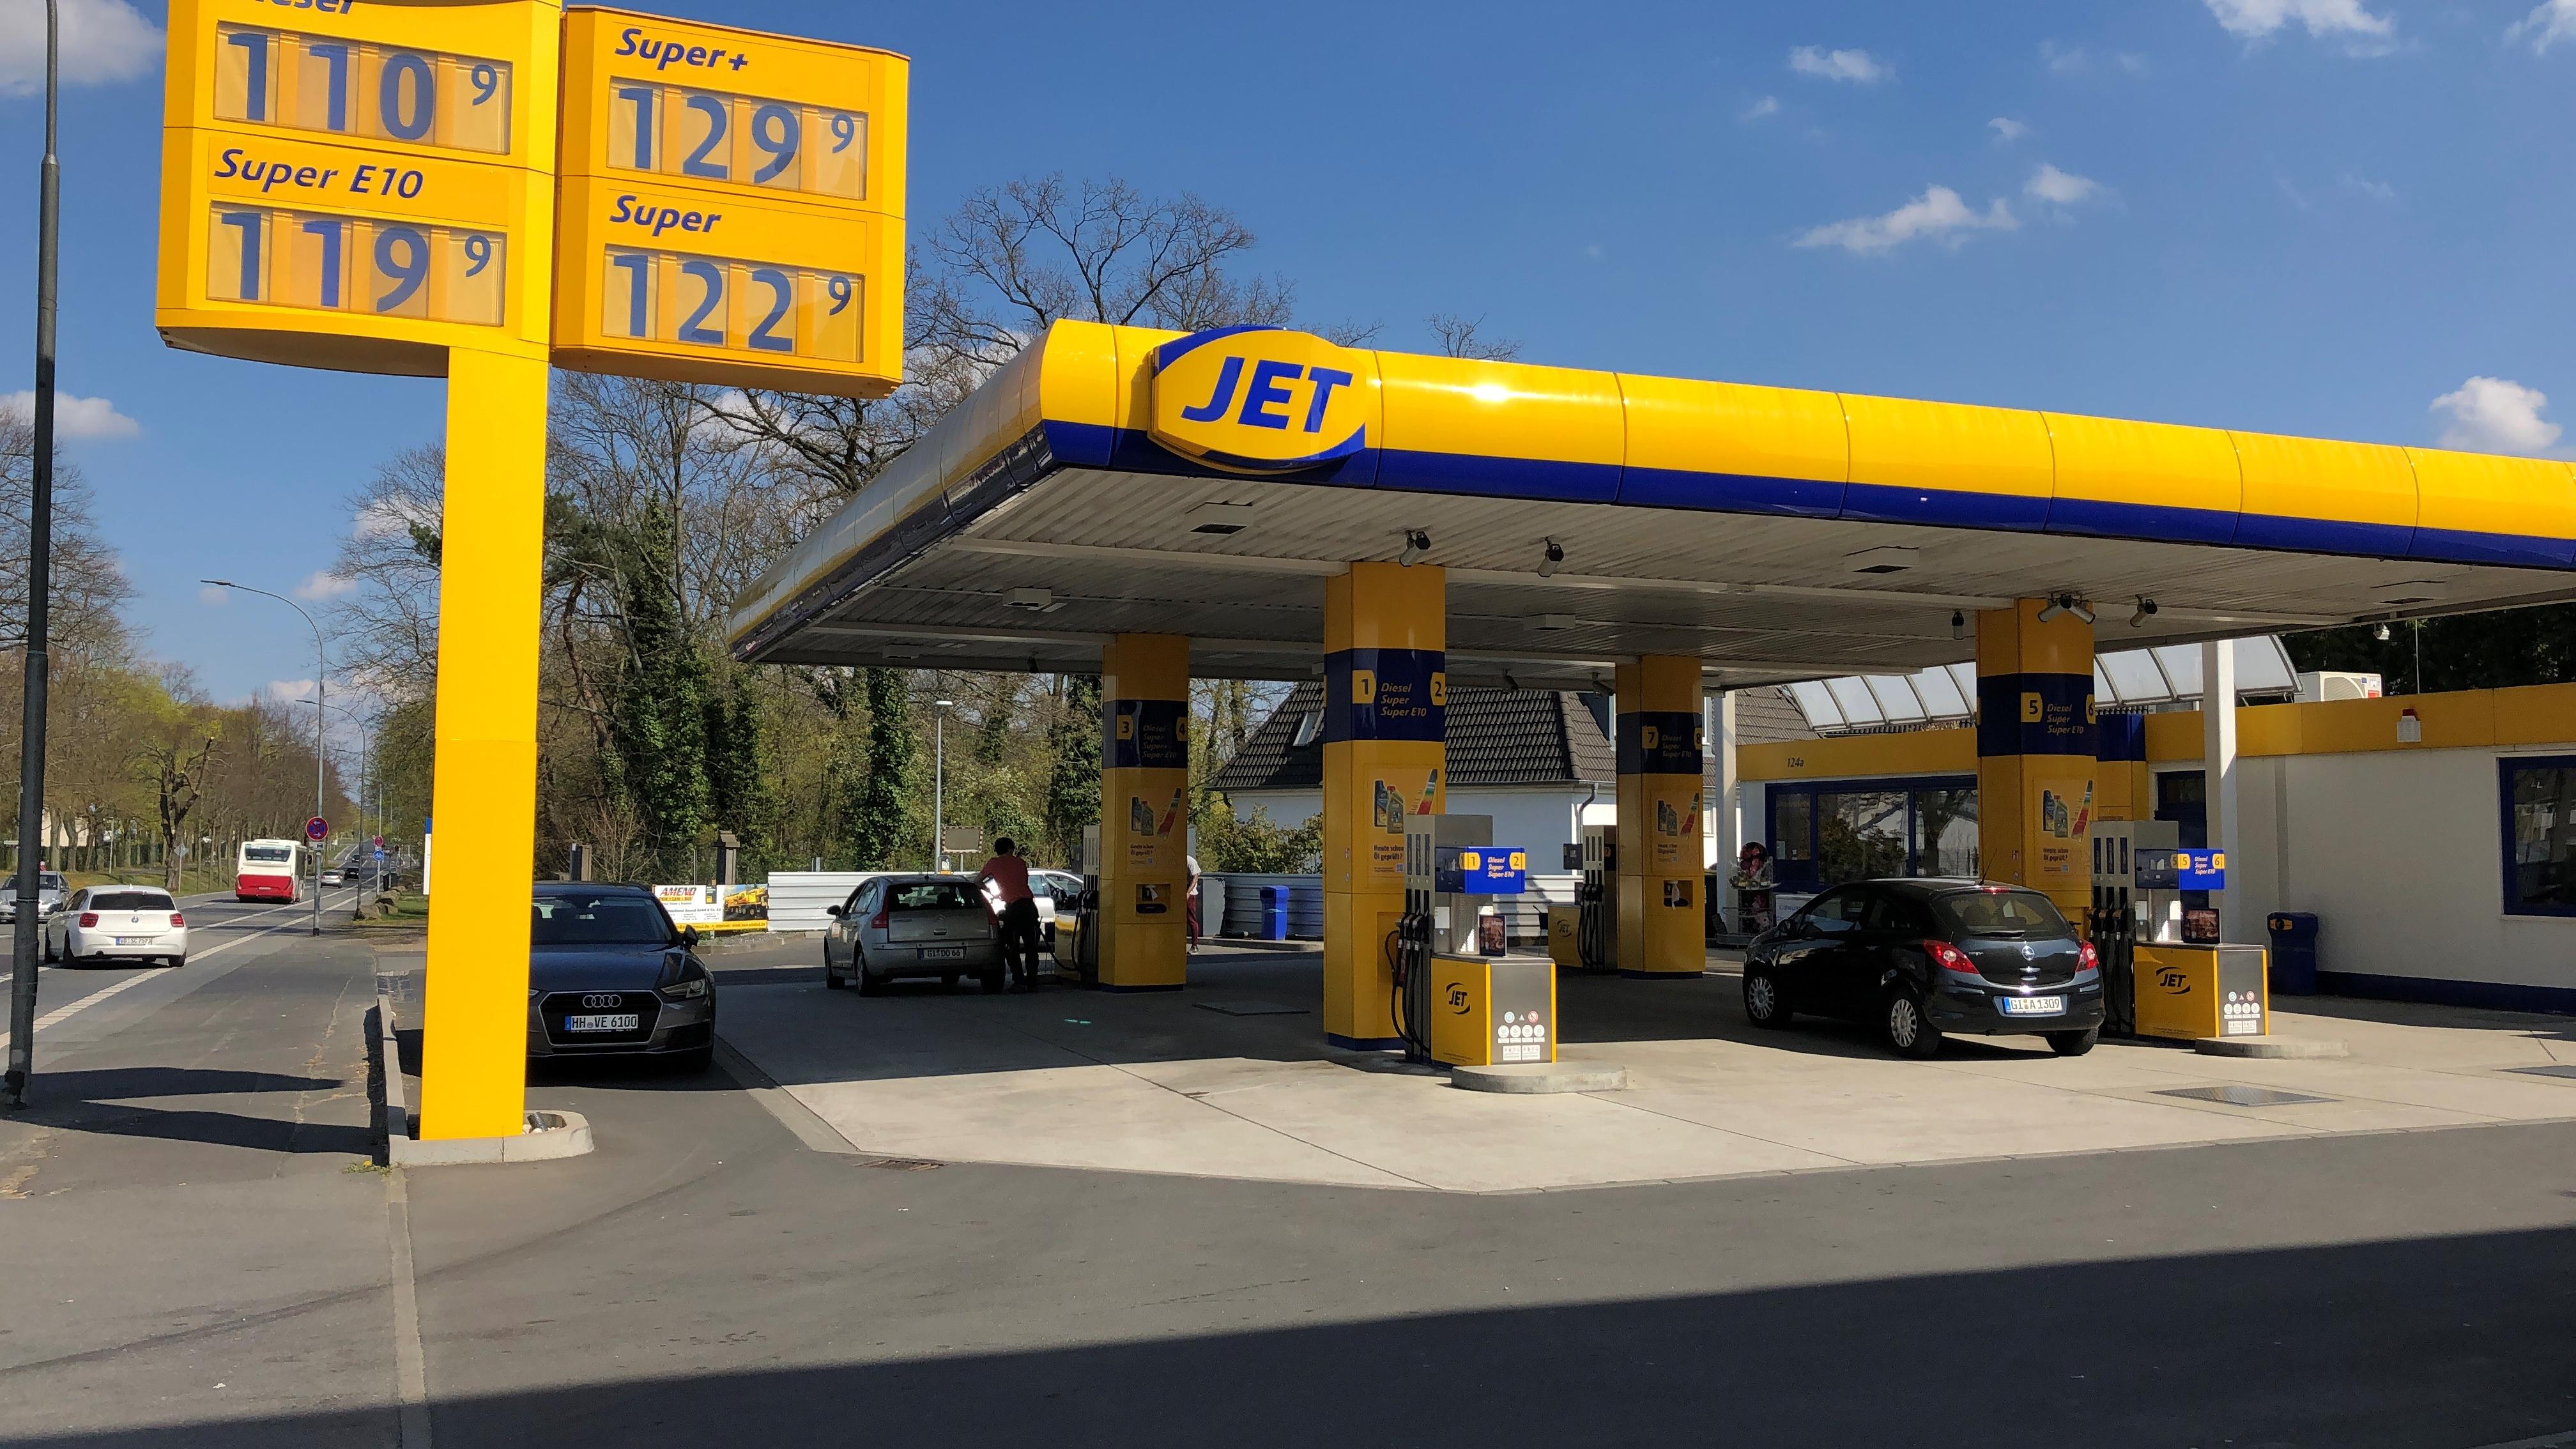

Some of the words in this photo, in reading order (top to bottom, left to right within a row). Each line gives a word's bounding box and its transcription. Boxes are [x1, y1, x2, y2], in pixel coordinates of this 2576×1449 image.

[615, 28, 749, 71] Super+
[227, 33, 434, 140] 110
[471, 65, 497, 105] 9
[619, 88, 799, 184] 129
[831, 114, 854, 153] 9
[214, 148, 339, 192] Super
[349, 164, 423, 198] E10
[609, 195, 722, 236] Super
[221, 212, 428, 312] 119
[464, 235, 491, 277] 9
[613, 255, 792, 350] 122
[828, 276, 851, 316] 9
[1180, 356, 1353, 433] JET
[1361, 678, 1368, 694] 1
[1381, 683, 1412, 693] Diesel
[1435, 681, 1442, 696] 2
[1381, 695, 1409, 707] Super
[2029, 700, 2038, 714] 5
[1381, 707, 1409, 718] Super
[1411, 707, 1427, 717] E10
[2047, 703, 2073, 712] Diesel
[2089, 702, 2094, 716] 6
[2047, 714, 2071, 724] Super
[1121, 721, 1130, 733] 3
[1179, 723, 1186, 735] 4
[2047, 725, 2071, 736] Super
[1648, 732, 1655, 743] 7
[1696, 733, 1701, 744] 8
[1787, 757, 1804, 767] 124a
[1471, 856, 1475, 866] 1
[1513, 856, 1519, 866] 2
[2182, 857, 2188, 865] 5
[2214, 857, 2220, 865] 6
[660, 887, 697, 896] AMEND
[2159, 973, 2186, 988] JET
[1448, 990, 1468, 1007] JET
[2011, 999, 2023, 1009] GI
[2030, 999, 2035, 1009] A
[2037, 999, 2060, 1009] 1309
[572, 1016, 586, 1029] HH
[595, 1016, 608, 1028] VE
[611, 1016, 637, 1027] 6100
